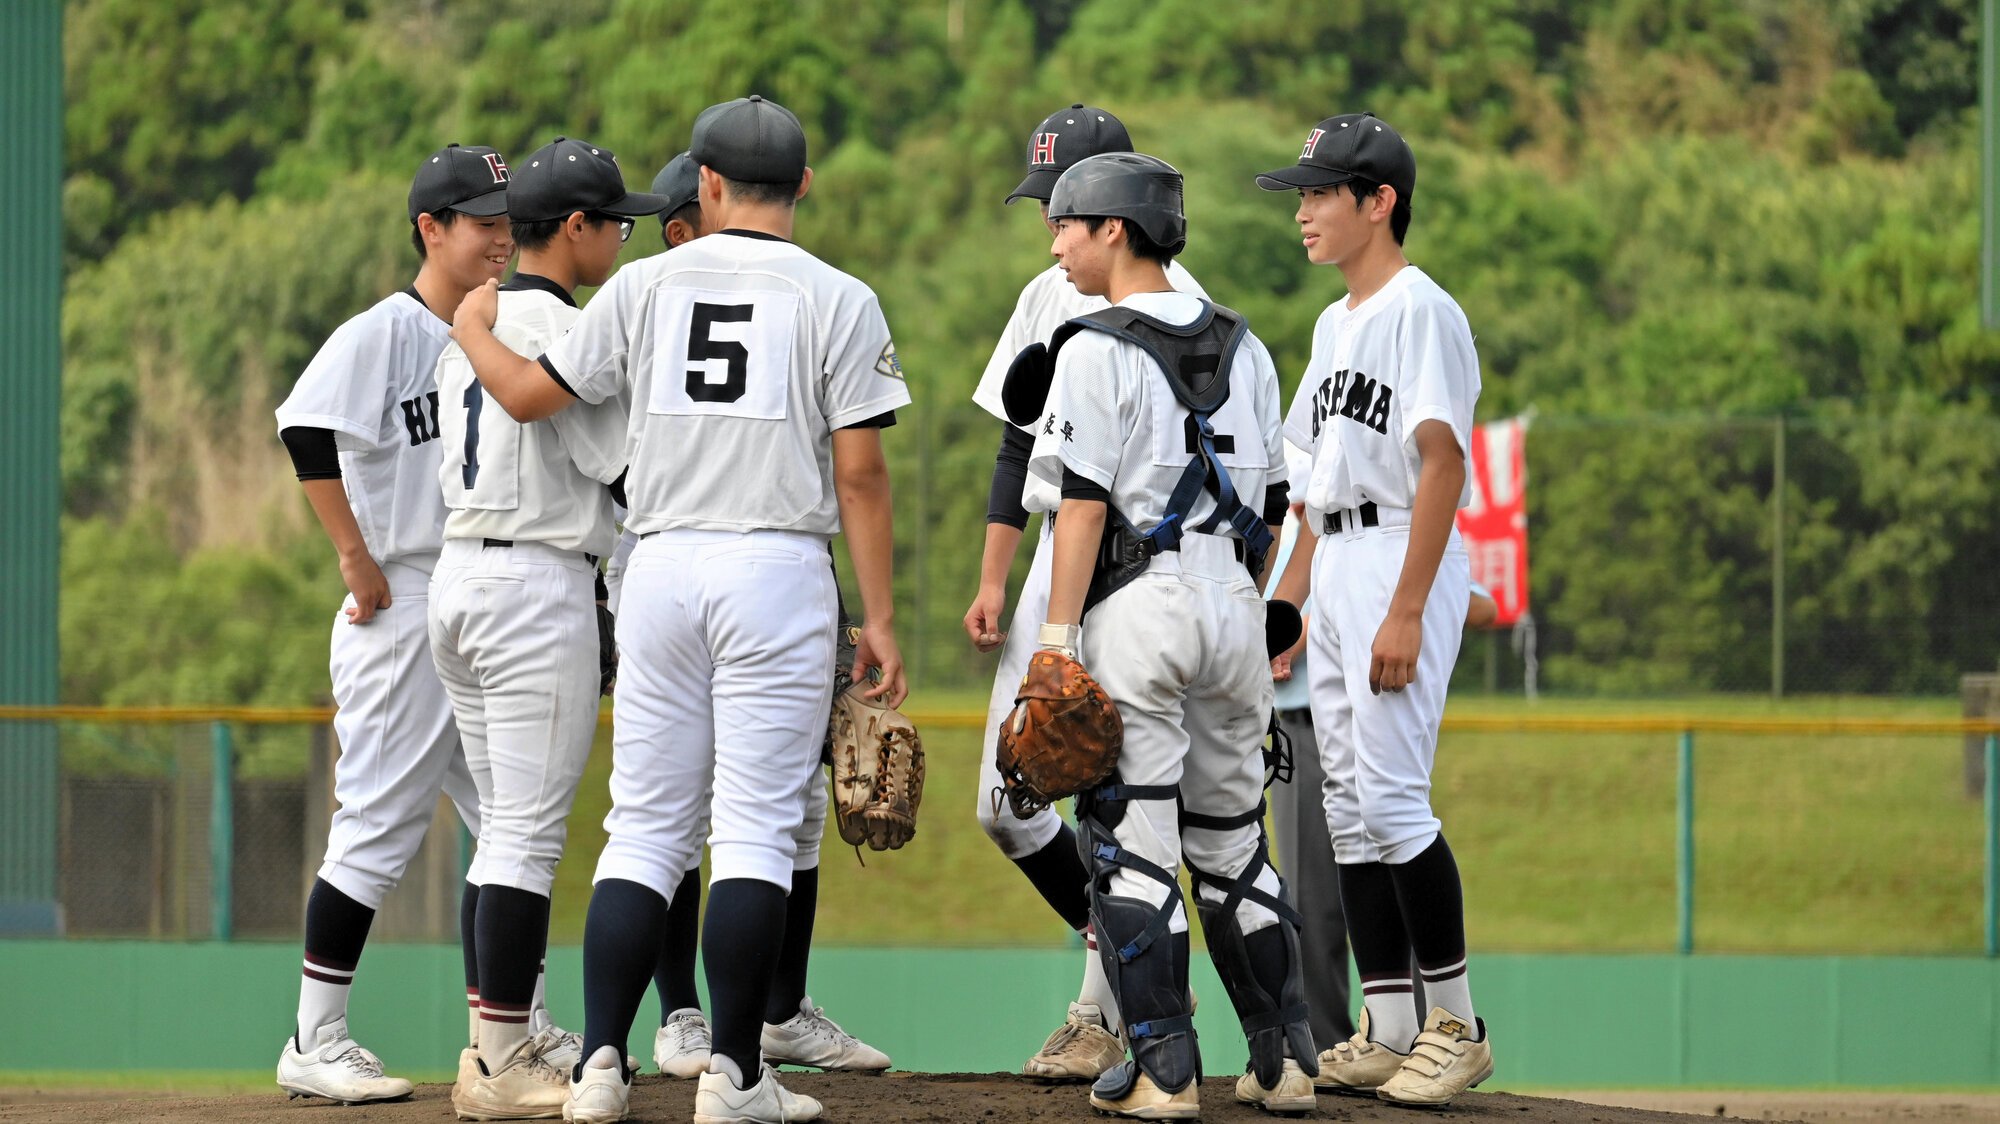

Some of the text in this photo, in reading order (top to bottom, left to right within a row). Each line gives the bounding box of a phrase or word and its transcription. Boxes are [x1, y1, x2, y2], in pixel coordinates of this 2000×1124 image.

[1032, 132, 1059, 165] H
[1298, 128, 1326, 159] H
[482, 153, 513, 184] H
[685, 302, 754, 403] 5
[462, 377, 484, 490] 1
